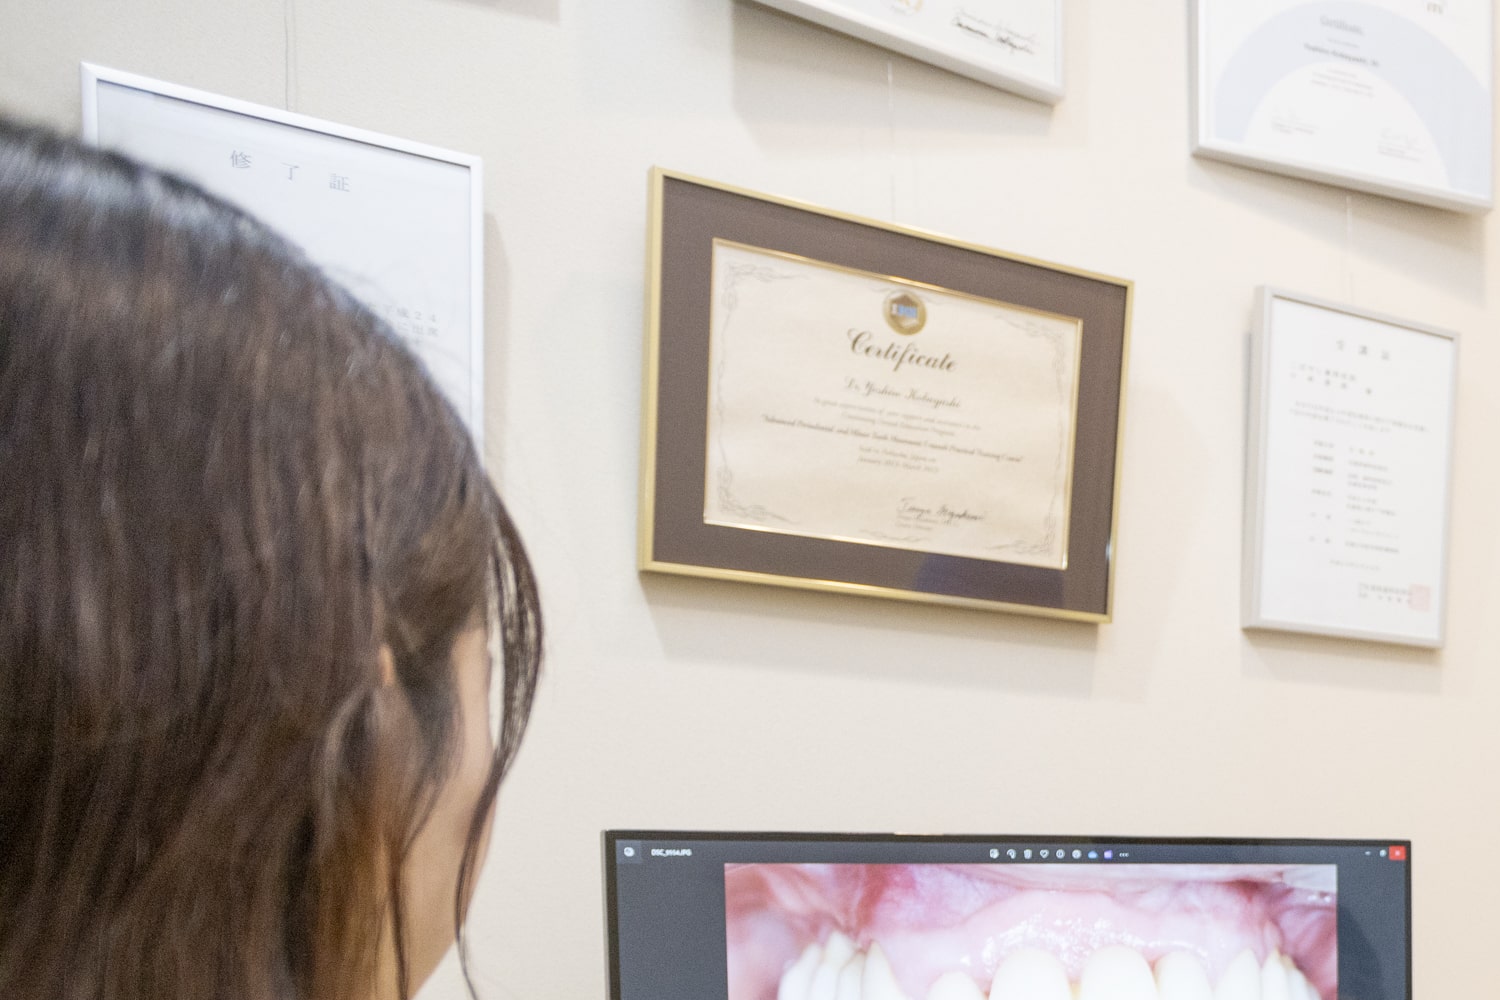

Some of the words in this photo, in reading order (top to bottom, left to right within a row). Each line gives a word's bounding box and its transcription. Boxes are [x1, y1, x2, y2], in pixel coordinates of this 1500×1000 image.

[230, 150, 350, 192] 修了証
[847, 328, 957, 372] Certificate
